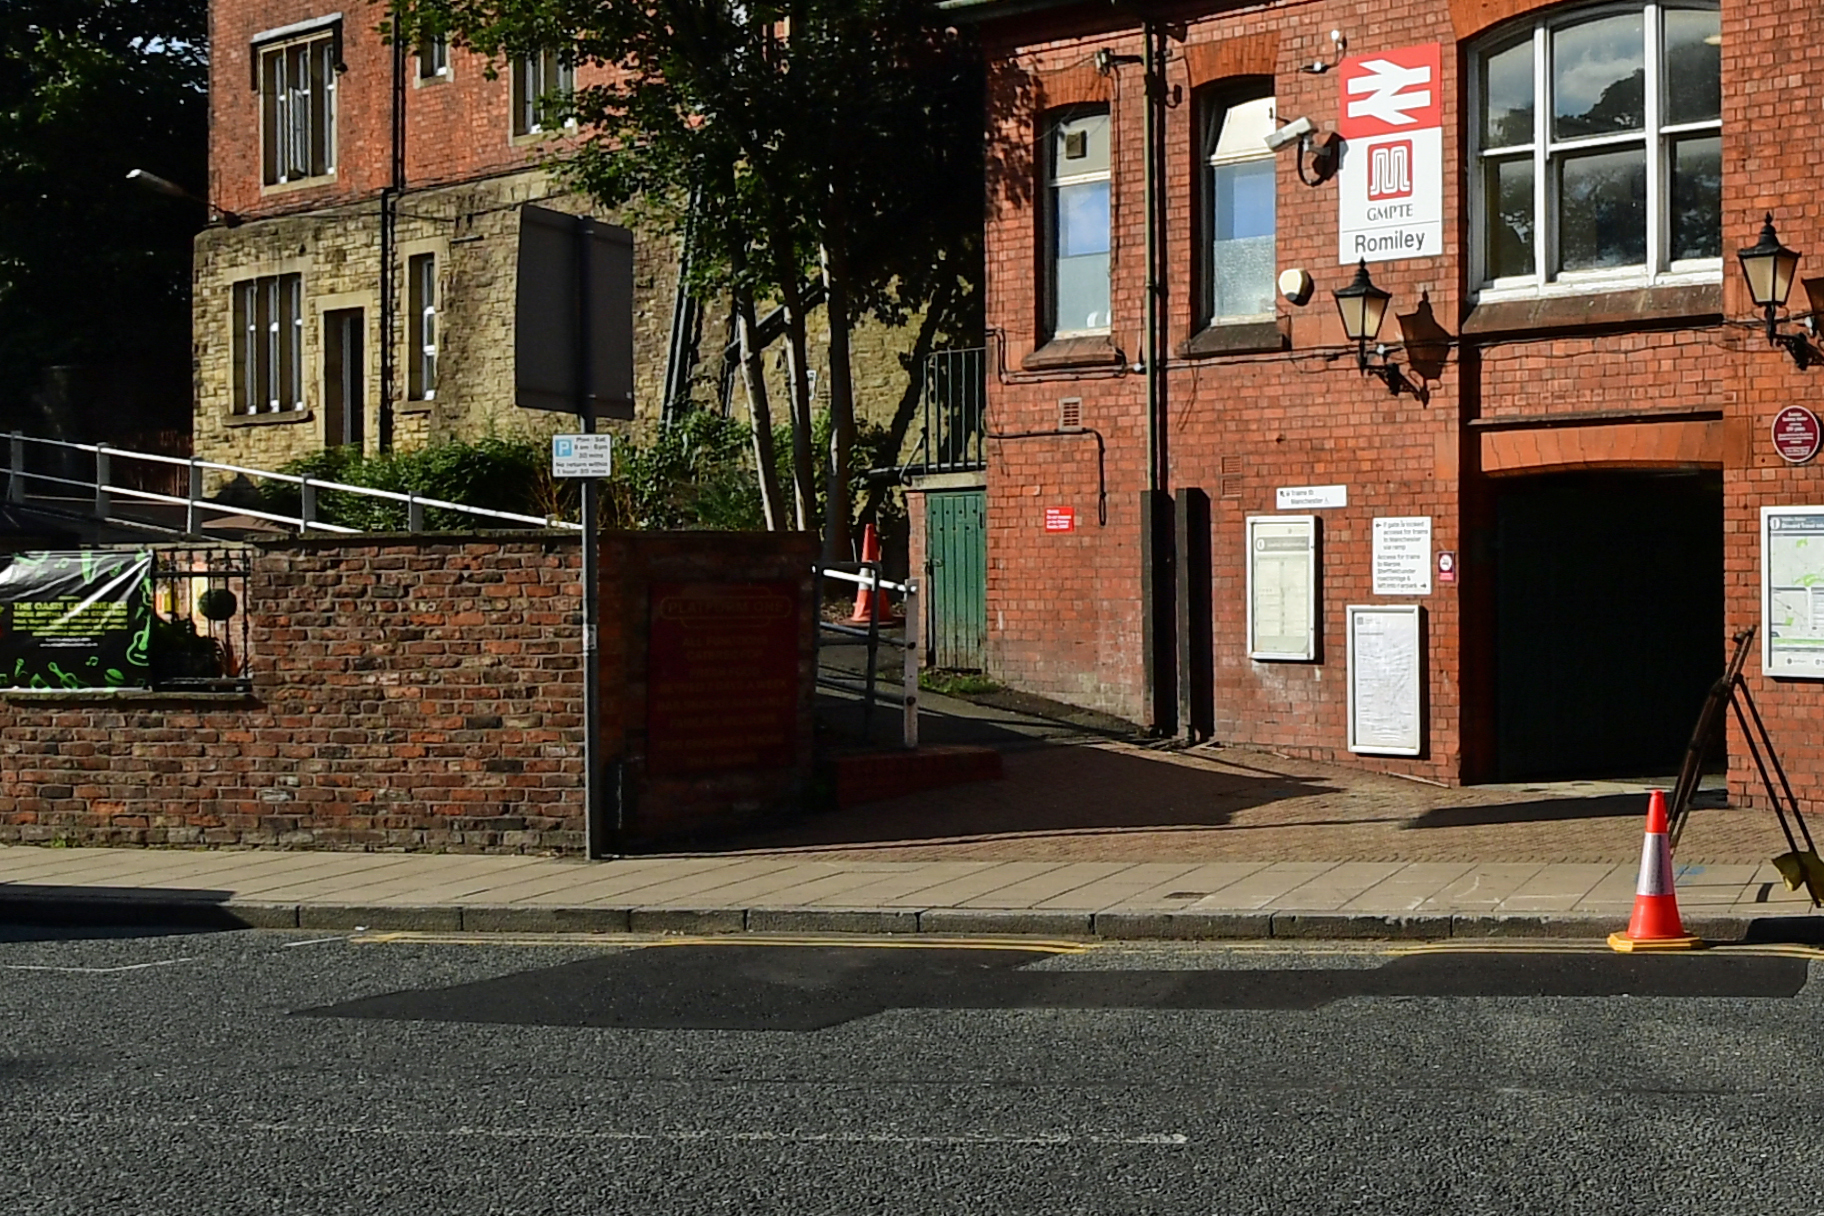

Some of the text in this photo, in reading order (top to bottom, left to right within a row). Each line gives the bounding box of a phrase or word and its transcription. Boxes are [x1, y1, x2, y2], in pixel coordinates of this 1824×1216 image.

[1367, 204, 1413, 221] GMPTE
[1355, 230, 1425, 253] Romiley
[13, 602, 32, 610] THE
[34, 602, 64, 610] OASIS
